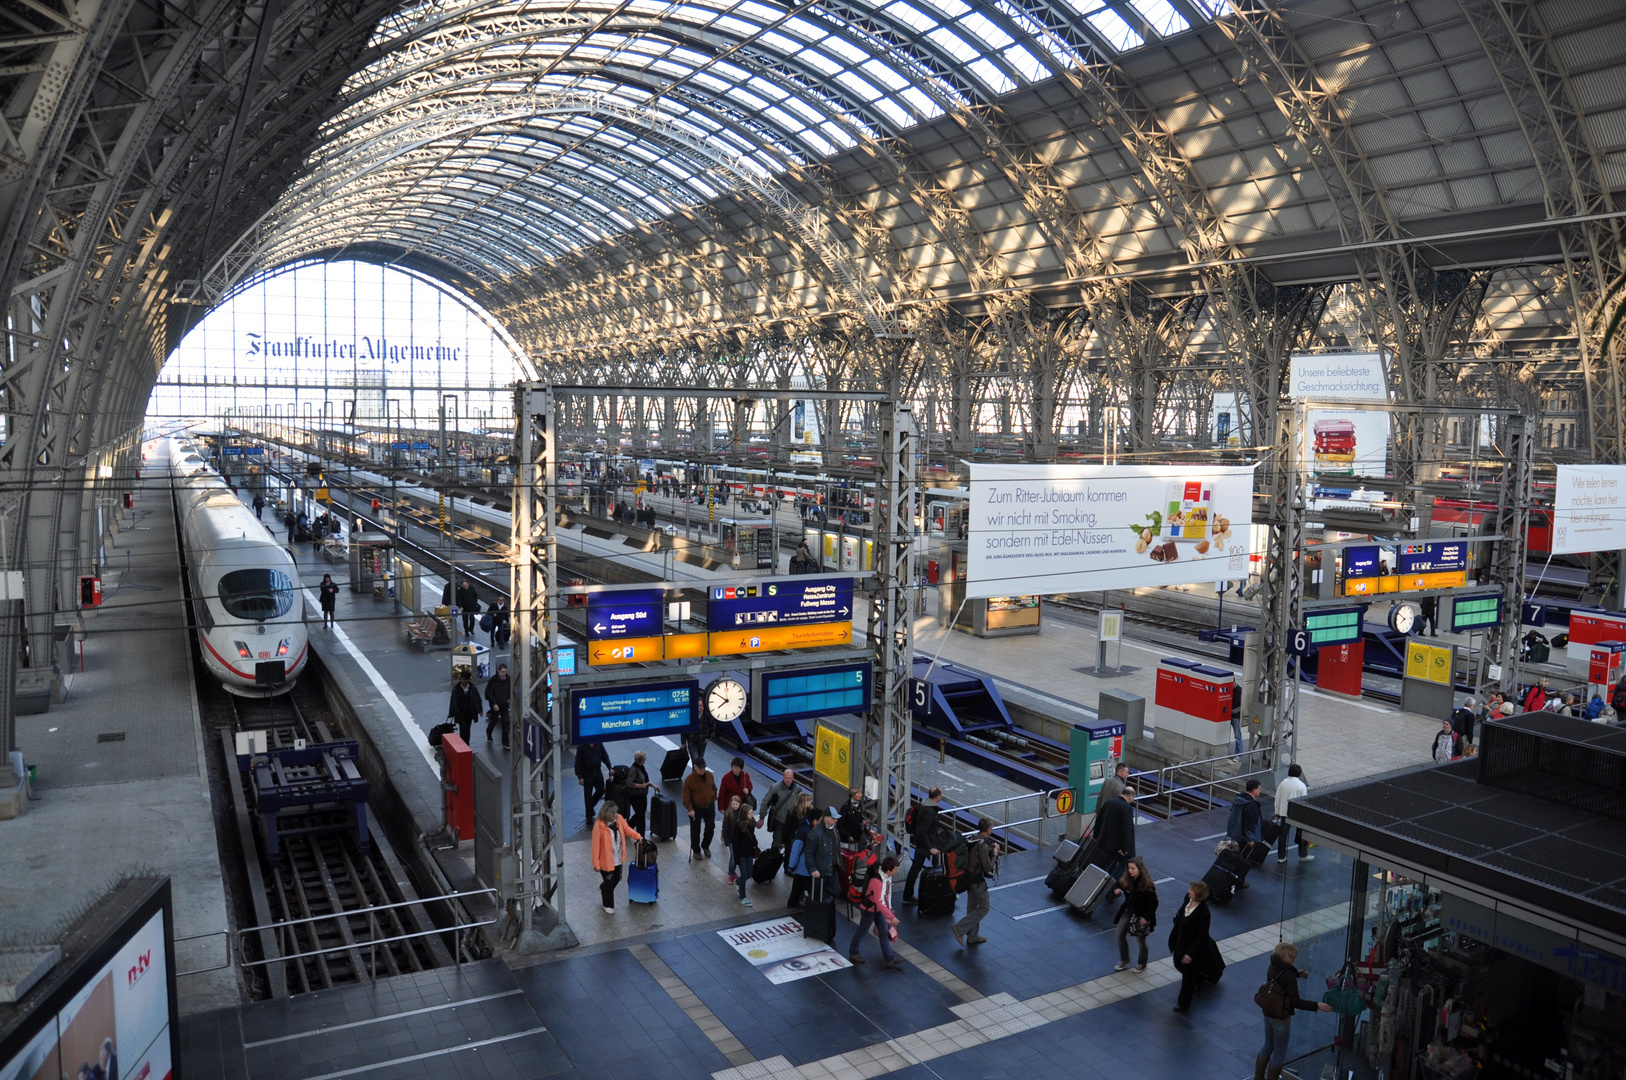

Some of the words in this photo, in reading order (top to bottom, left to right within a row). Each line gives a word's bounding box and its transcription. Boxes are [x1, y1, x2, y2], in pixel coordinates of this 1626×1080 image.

[245, 333, 355, 361] Frankfurter
[359, 336, 460, 364] Allgemeine
[1298, 367, 1325, 378] Unsere
[1326, 365, 1370, 377] beliebteste
[1298, 380, 1381, 394] Geschmacksrichtung:
[1573, 477, 1584, 488] Wer
[988, 488, 1012, 504] Zum
[1016, 487, 1084, 504] Ritter-Jubiläum
[1087, 487, 1127, 503] kommen
[1594, 492, 1608, 505] kann
[1608, 492, 1618, 505] hier
[987, 512, 1004, 526] wir
[1008, 508, 1032, 526] nicht
[1034, 510, 1050, 524] mit
[1052, 508, 1098, 528] Smoking,
[986, 531, 1031, 549] sondern
[1034, 532, 1049, 546] mit
[1052, 530, 1115, 546] Edel-Nüssen.
[716, 588, 724, 599] U
[768, 586, 777, 596] S
[803, 593, 836, 602] ReiseZentrum
[805, 586, 827, 597] Ausgang
[827, 585, 837, 594] City
[610, 612, 634, 621] Ausgang
[635, 611, 648, 619] Süd
[1530, 604, 1542, 622] 7
[1294, 632, 1306, 651] 6
[856, 670, 863, 682] 5
[578, 698, 586, 711] 4
[672, 690, 690, 698] 07:54
[916, 682, 926, 706] 5
[602, 720, 632, 730] München
[632, 718, 644, 726] Hbf
[526, 723, 534, 752] 4
[728, 922, 803, 946] ENTFÜHRT
[1450, 917, 1489, 940] BEAUTY
[1496, 935, 1544, 962] EXPRESS
